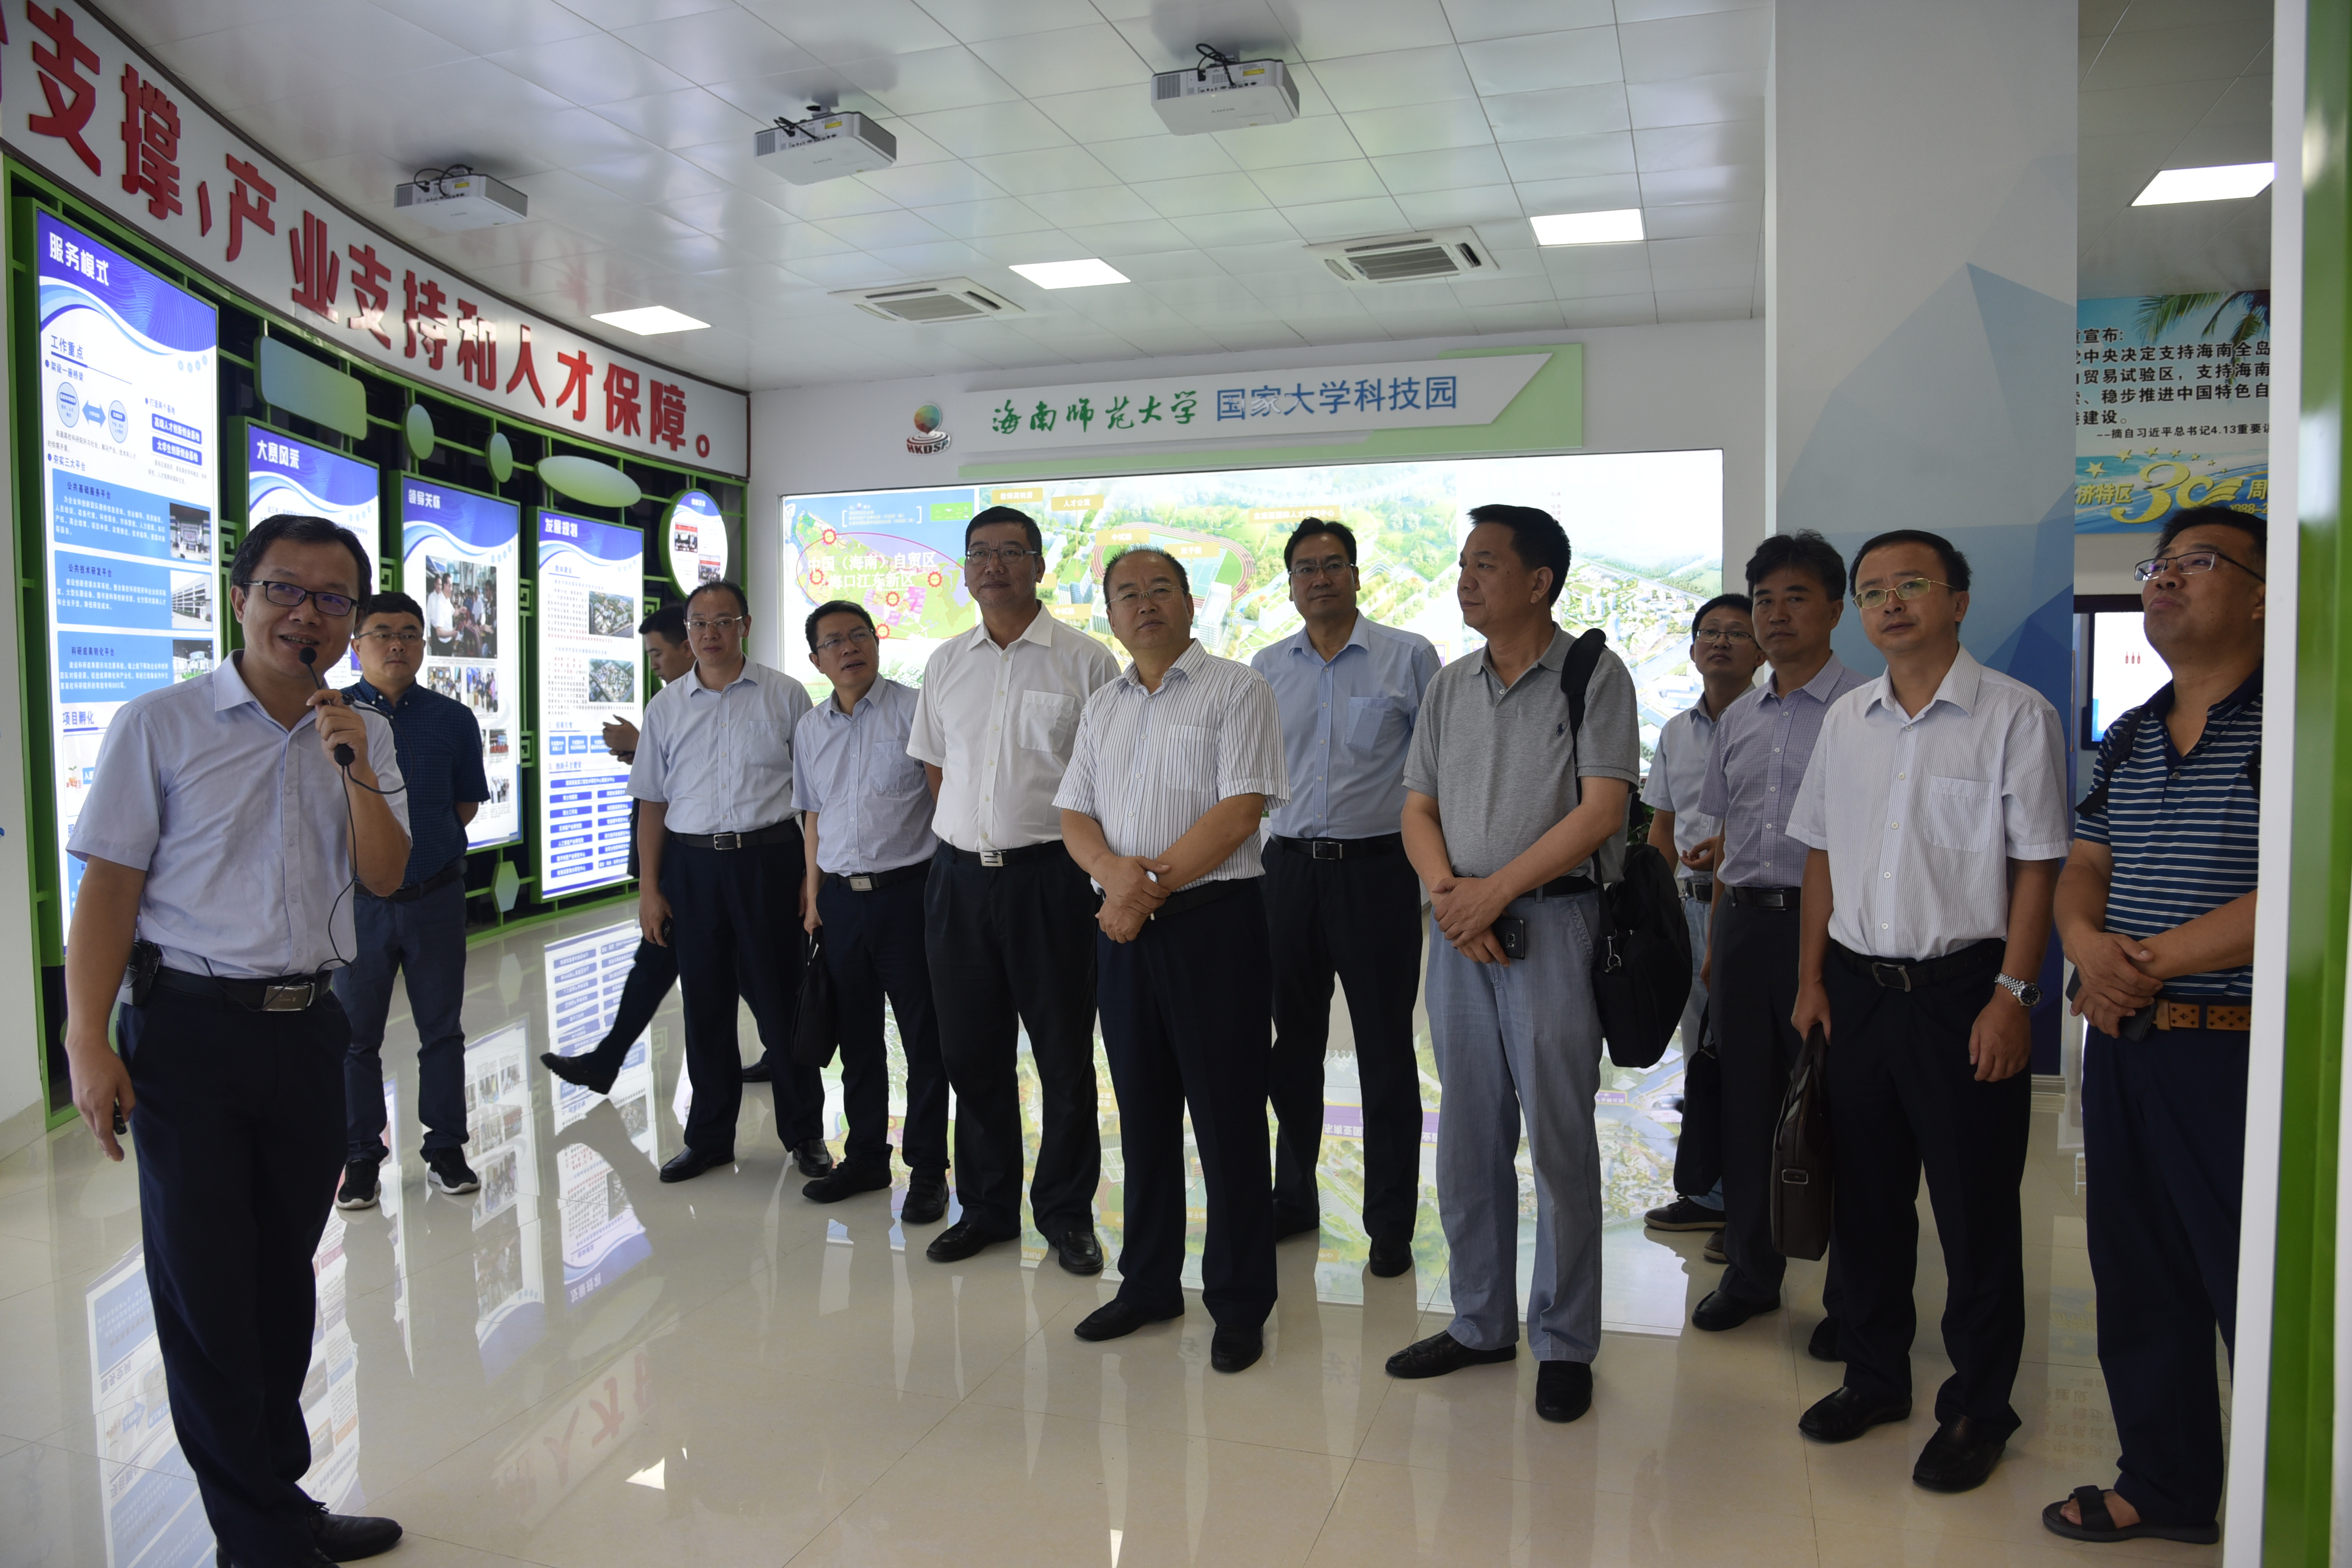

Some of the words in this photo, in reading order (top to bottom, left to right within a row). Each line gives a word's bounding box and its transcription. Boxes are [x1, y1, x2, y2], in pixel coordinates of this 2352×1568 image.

[0, 0, 710, 459] 支撑、产业支持和人才保障。
[49, 231, 109, 286] 服务模式
[51, 334, 84, 361] 工作重点
[51, 361, 84, 382] 架设一座桥梁
[2076, 362, 2270, 385] 贸易试验区，支持海南
[992, 390, 1197, 434] 海南师范大学
[1216, 375, 1457, 422] 国家大学科技园
[154, 416, 200, 442] 高端人才创新创业基地
[157, 440, 199, 462] 大学生创新创业基地
[257, 439, 299, 469] 大赛风采
[906, 439, 949, 454] HKDSP
[53, 454, 86, 472] 夯实三大平台
[67, 481, 111, 499] 公共基础服务平台
[408, 488, 441, 510] 领导关怀
[2075, 483, 2134, 506] 济特区
[1063, 498, 1091, 507] 人才公寓
[545, 518, 578, 538] 发展规划
[68, 564, 112, 578] 公共技术研发平台
[828, 571, 914, 590] 海口江东新区
[71, 646, 115, 657] 科研成果转化平台
[62, 710, 94, 726] 项目孵化
